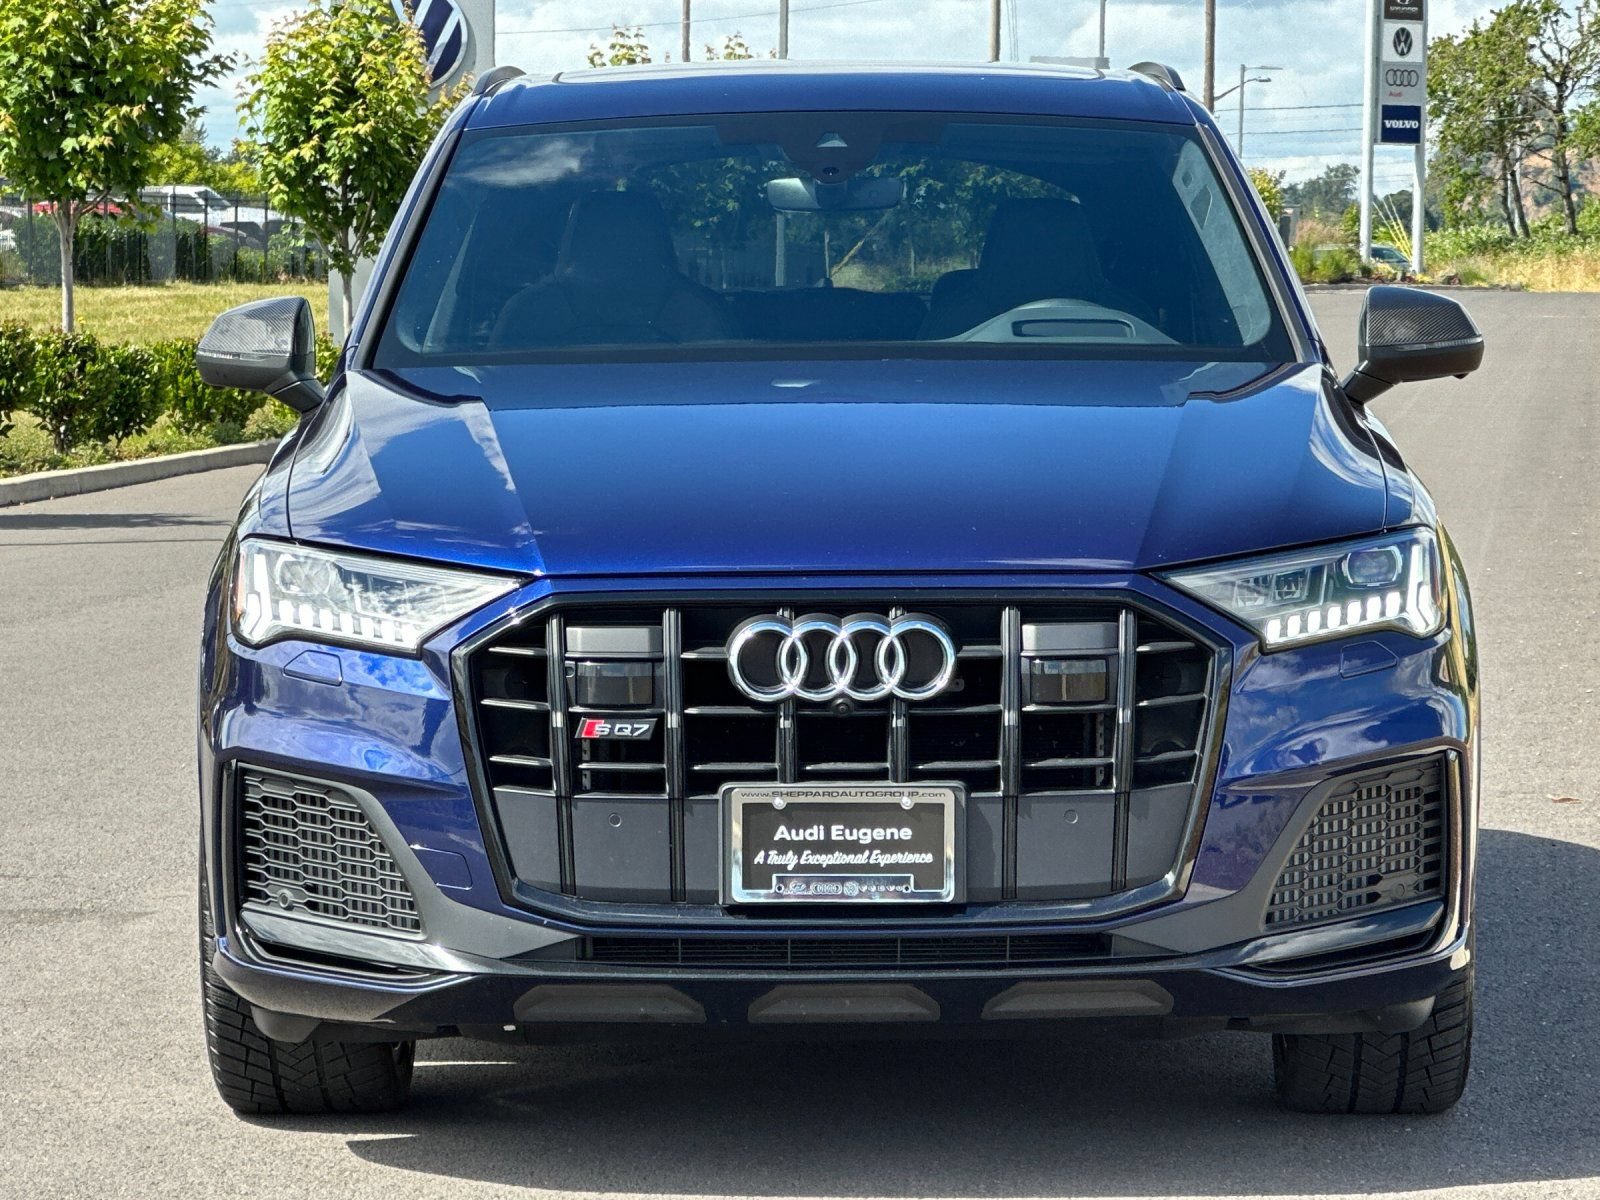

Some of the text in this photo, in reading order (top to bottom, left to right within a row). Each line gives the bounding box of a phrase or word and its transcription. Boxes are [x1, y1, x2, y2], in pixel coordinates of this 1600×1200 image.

[1384, 120, 1419, 129] VOLVO
[594, 723, 650, 736] SQ7
[741, 790, 946, 798] www.SHEPPARDAUTOGROUP.com
[773, 825, 913, 844] Audi Eugene
[754, 850, 933, 871] A Truly Exceptional Experience
